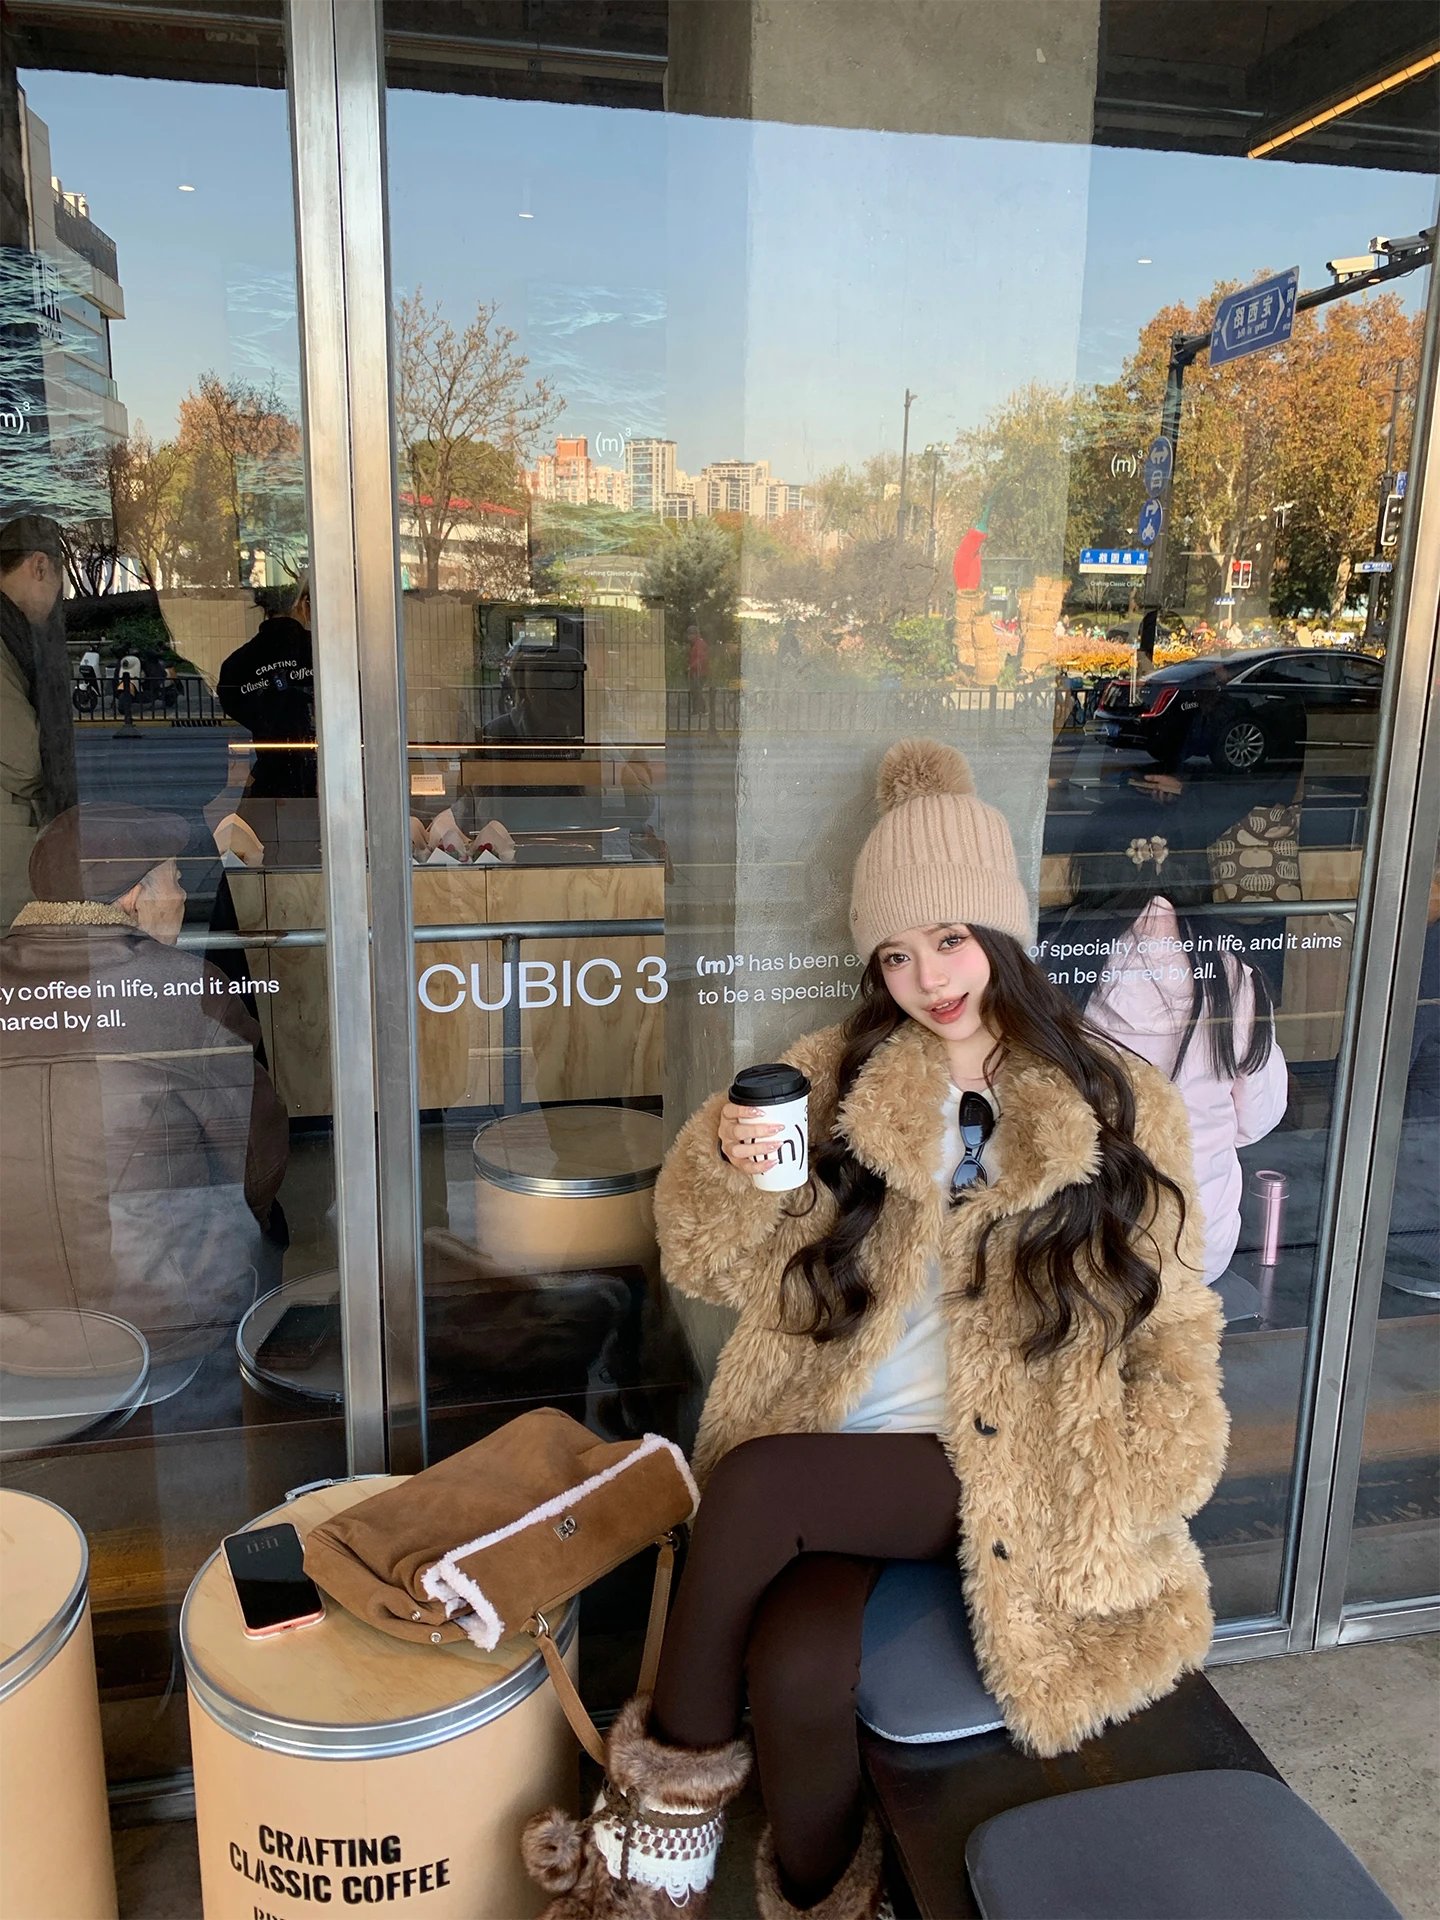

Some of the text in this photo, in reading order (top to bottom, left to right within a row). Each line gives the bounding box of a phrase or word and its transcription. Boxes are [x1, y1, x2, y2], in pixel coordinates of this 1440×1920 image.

[255, 660, 298, 676] CRAFTING
[240, 678, 270, 694] Classic
[1028, 932, 1342, 961] of specialty coffee in life, and it aims
[749, 954, 784, 972] has
[789, 952, 839, 970] been
[1073, 967, 1098, 984] be
[1101, 964, 1164, 983] shared
[1168, 964, 1190, 983] by
[1193, 962, 1217, 980] all.
[18, 981, 92, 1001] coffee
[96, 980, 116, 998] in
[120, 979, 158, 999] life,
[163, 977, 204, 996] and
[209, 976, 224, 995] it
[228, 976, 280, 995] aims
[417, 955, 669, 1013] CUBIC 3
[697, 988, 719, 1006] to
[723, 986, 749, 1004] be
[753, 990, 766, 1002] a
[770, 980, 860, 1004] specialty
[63, 1010, 92, 1033] by
[96, 1009, 127, 1028] all.
[246, 1537, 280, 1554] 11:11
[258, 1824, 402, 1868] CRAFTING
[229, 1841, 451, 1905] CLASSIC COFFEE
